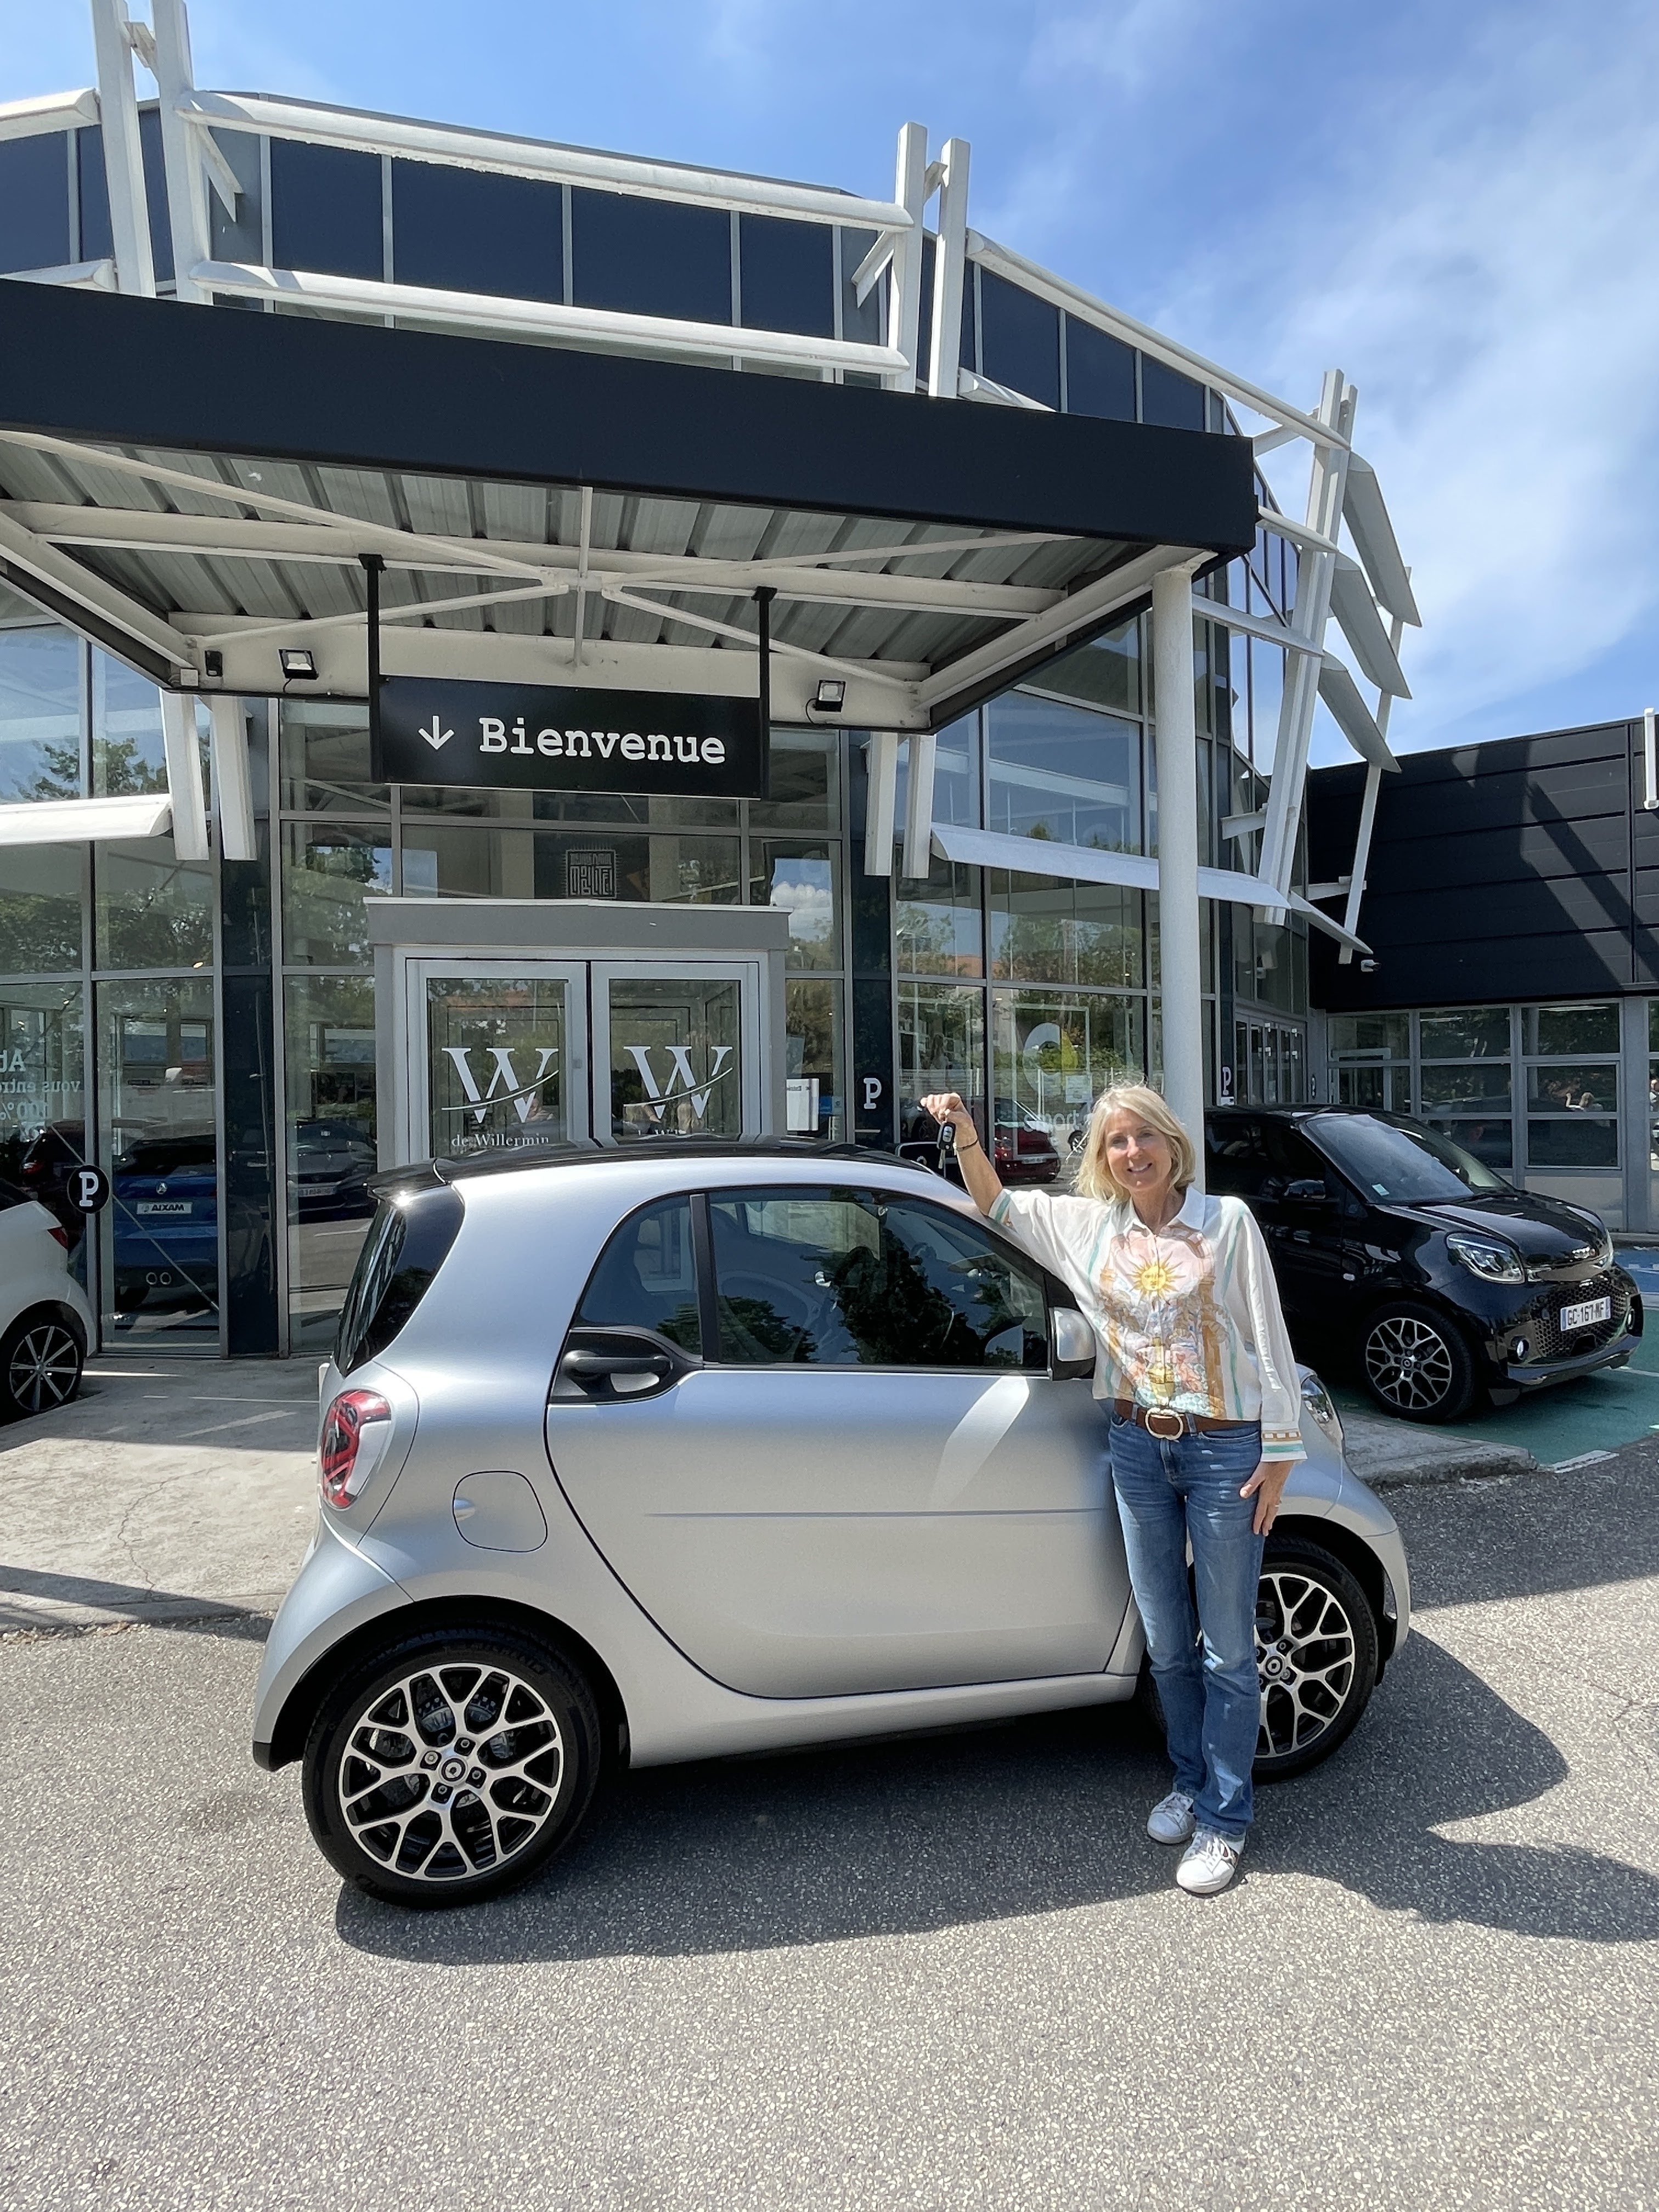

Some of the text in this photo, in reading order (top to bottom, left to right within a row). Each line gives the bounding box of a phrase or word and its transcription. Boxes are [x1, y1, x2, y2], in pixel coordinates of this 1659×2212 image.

[479, 717, 725, 764] Bienvenue
[441, 1048, 559, 1124] W
[623, 1046, 733, 1120] W
[864, 1077, 882, 1109] P
[1222, 1066, 1232, 1096] P
[451, 1133, 549, 1147] de Willermin
[79, 1172, 99, 1206] P
